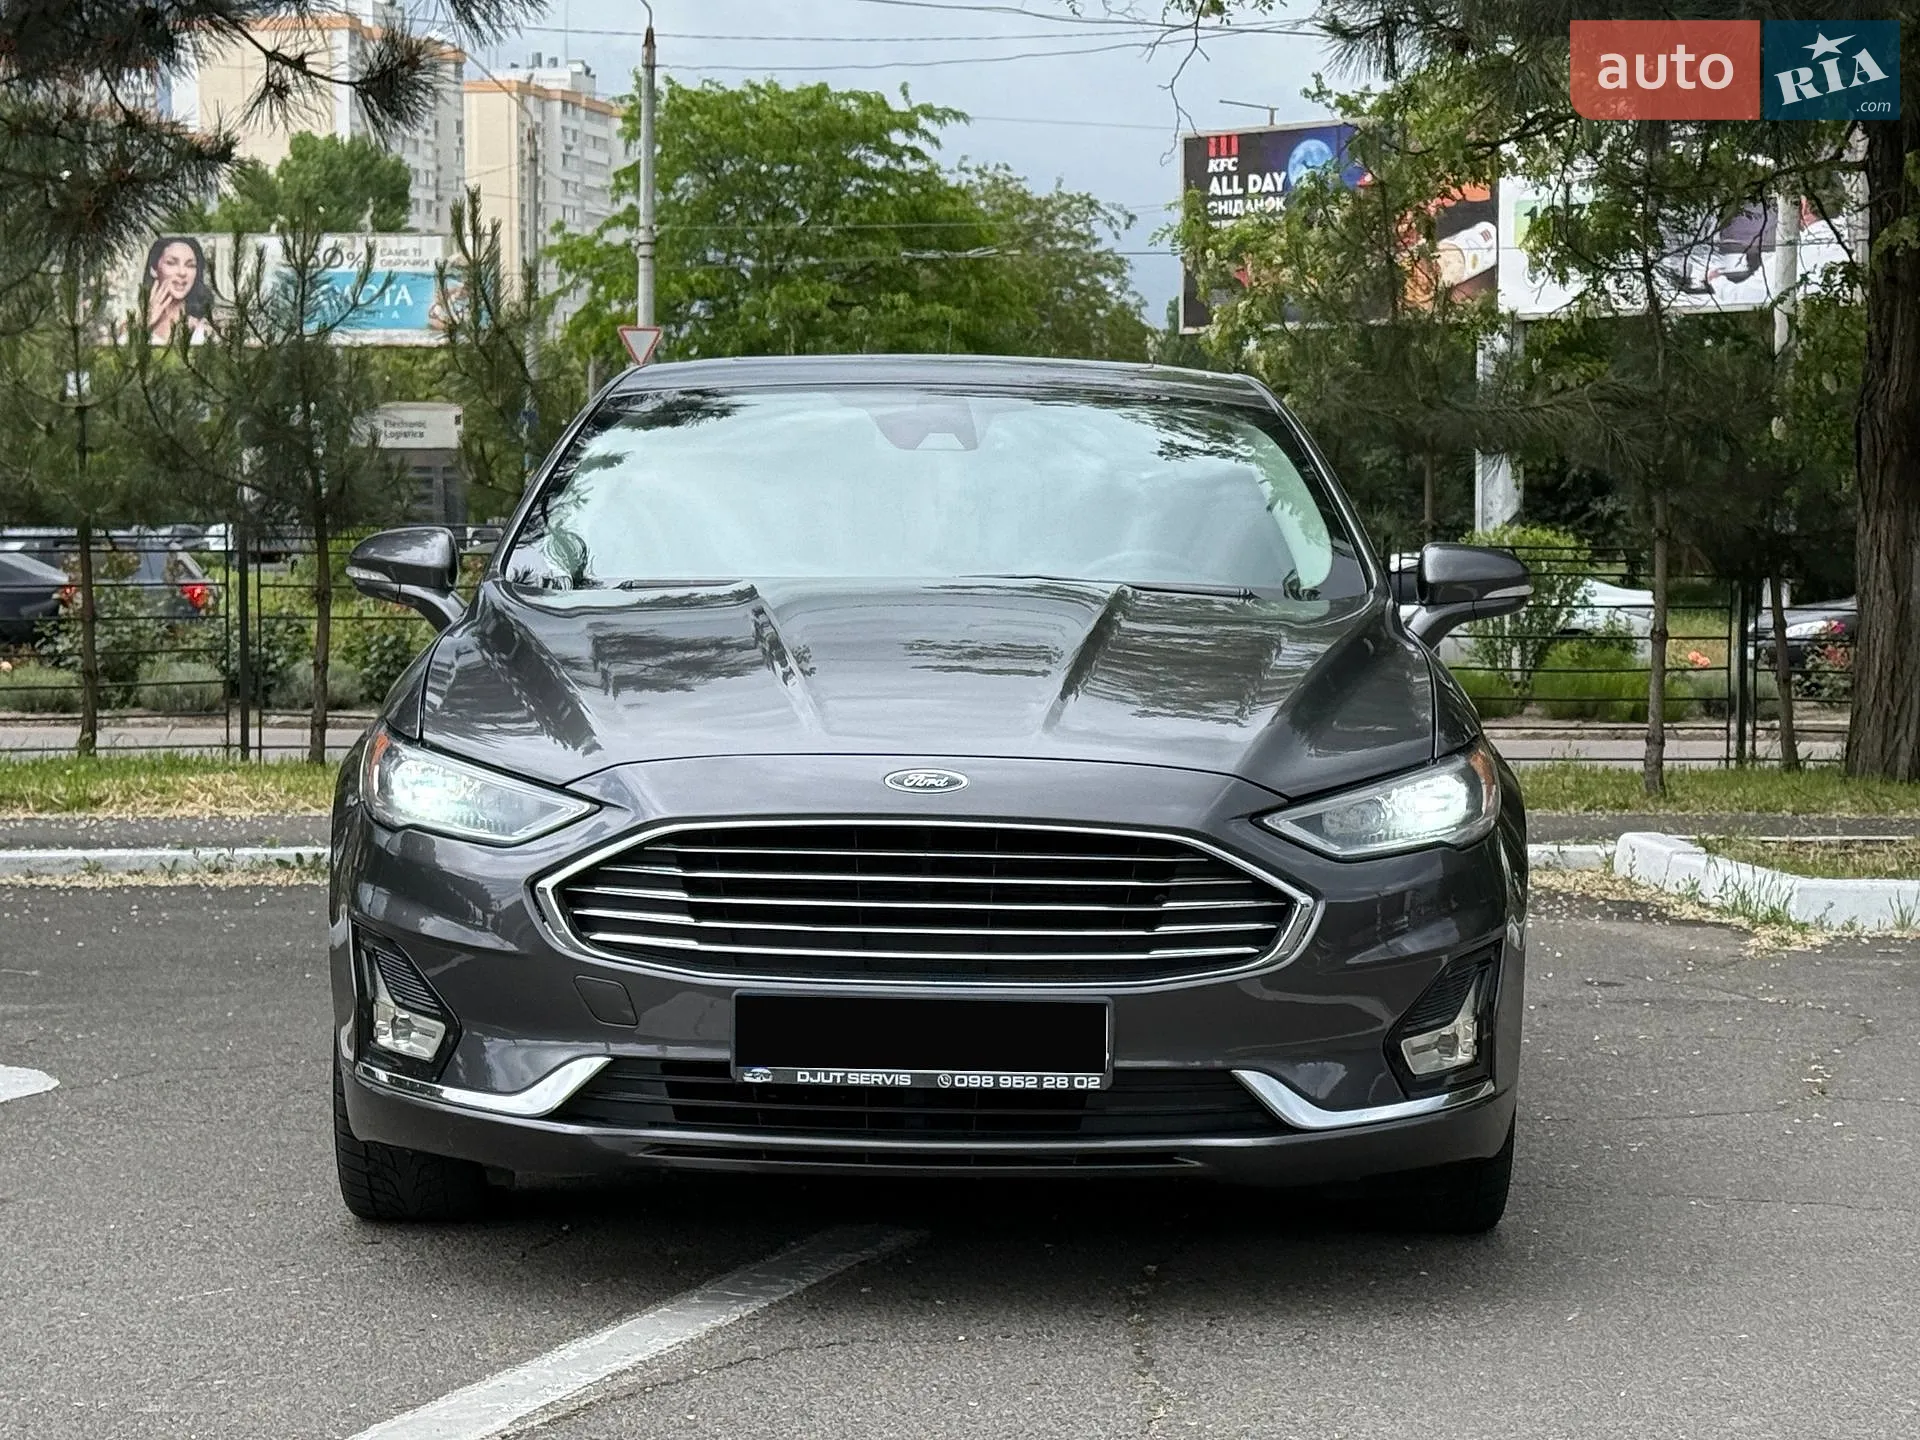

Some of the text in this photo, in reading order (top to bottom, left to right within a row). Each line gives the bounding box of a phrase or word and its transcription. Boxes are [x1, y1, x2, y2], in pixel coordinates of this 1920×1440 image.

[1207, 156, 1239, 173] KFC
[1208, 171, 1287, 196] ALL DAY
[903, 772, 949, 787] Ford
[847, 1072, 912, 1086] SERVIS
[954, 1075, 994, 1088] 098
[1043, 1076, 1069, 1089] 28
[1074, 1076, 1101, 1089] 02
